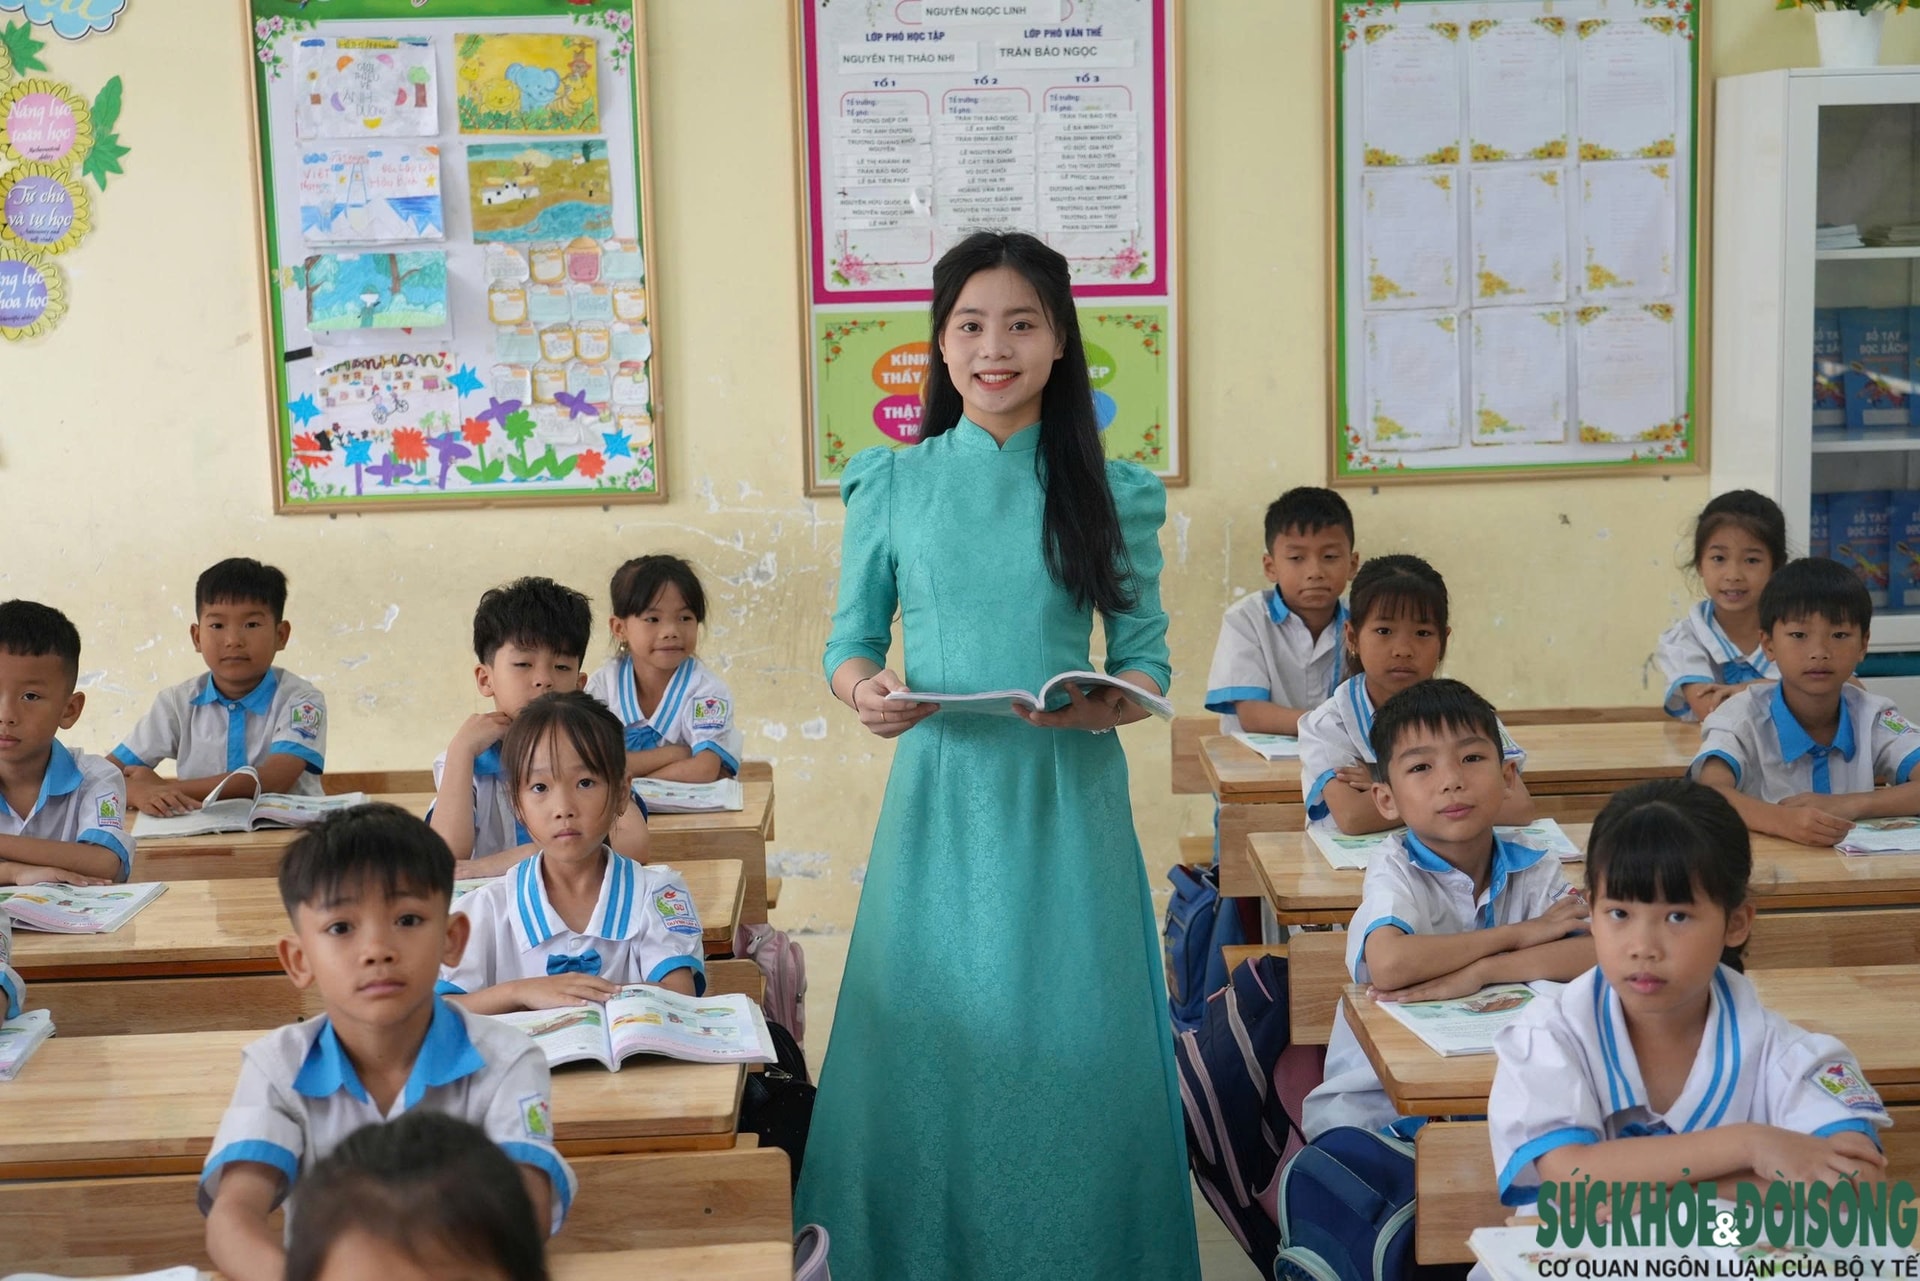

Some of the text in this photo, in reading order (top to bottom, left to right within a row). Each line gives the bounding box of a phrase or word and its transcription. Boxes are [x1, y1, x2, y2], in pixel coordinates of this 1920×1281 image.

[1003, 6, 1027, 15] LINH
[865, 31, 883, 42] LỚP
[906, 31, 926, 43] HỌC
[928, 29, 945, 42] TẬP
[1024, 28, 1041, 39] LỚP
[1063, 46, 1098, 58] NGỌC
[889, 54, 904, 65] THỊ
[937, 53, 956, 63] NHI
[1093, 75, 1100, 83] 3
[48, 207, 72, 228] học
[883, 403, 922, 421] THẬT
